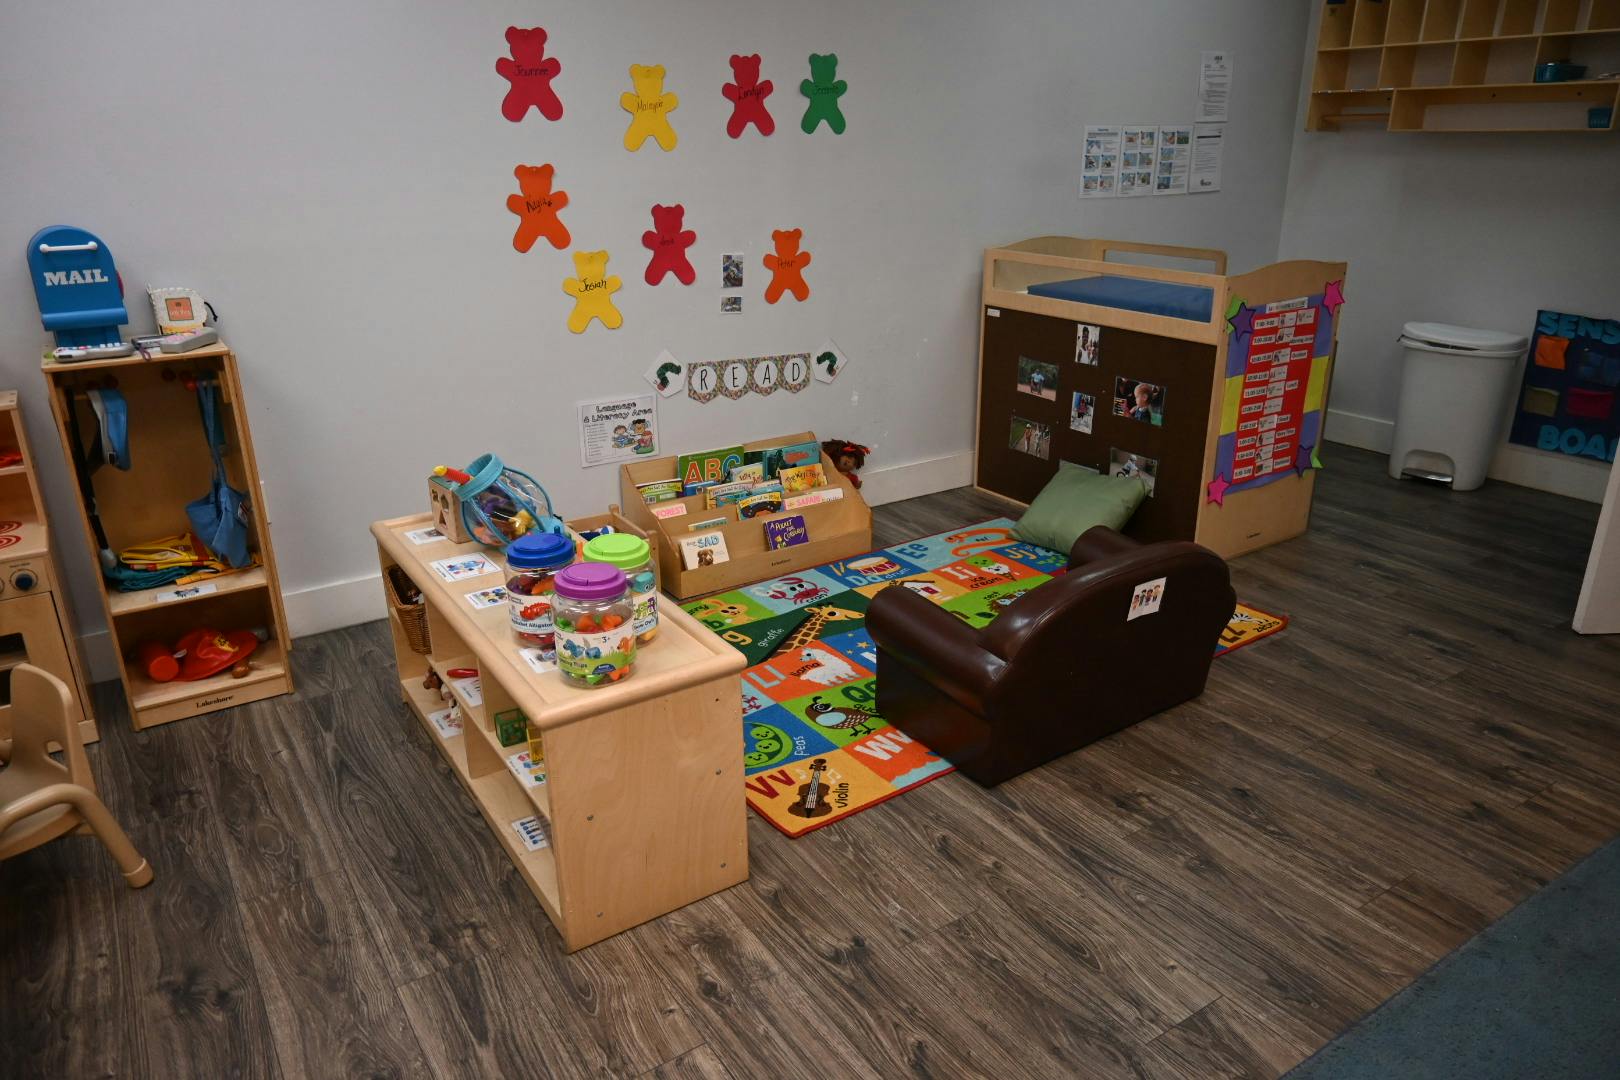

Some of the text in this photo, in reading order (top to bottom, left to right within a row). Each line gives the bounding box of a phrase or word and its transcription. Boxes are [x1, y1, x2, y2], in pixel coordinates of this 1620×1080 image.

[43, 268, 109, 287] MAIL
[578, 277, 607, 293] Josiah
[700, 362, 801, 391] READ
[592, 411, 629, 423] Literacy
[631, 408, 653, 417] Area
[595, 402, 637, 413] Language
[683, 454, 741, 485] ABC
[697, 534, 720, 549] SAD
[895, 543, 929, 559] Ee
[969, 577, 1003, 589] cream
[747, 664, 788, 689] Ll
[195, 694, 234, 709] Lakeshore
[793, 735, 810, 756] peas
[745, 769, 796, 799] Vv
[834, 782, 850, 808] violin
